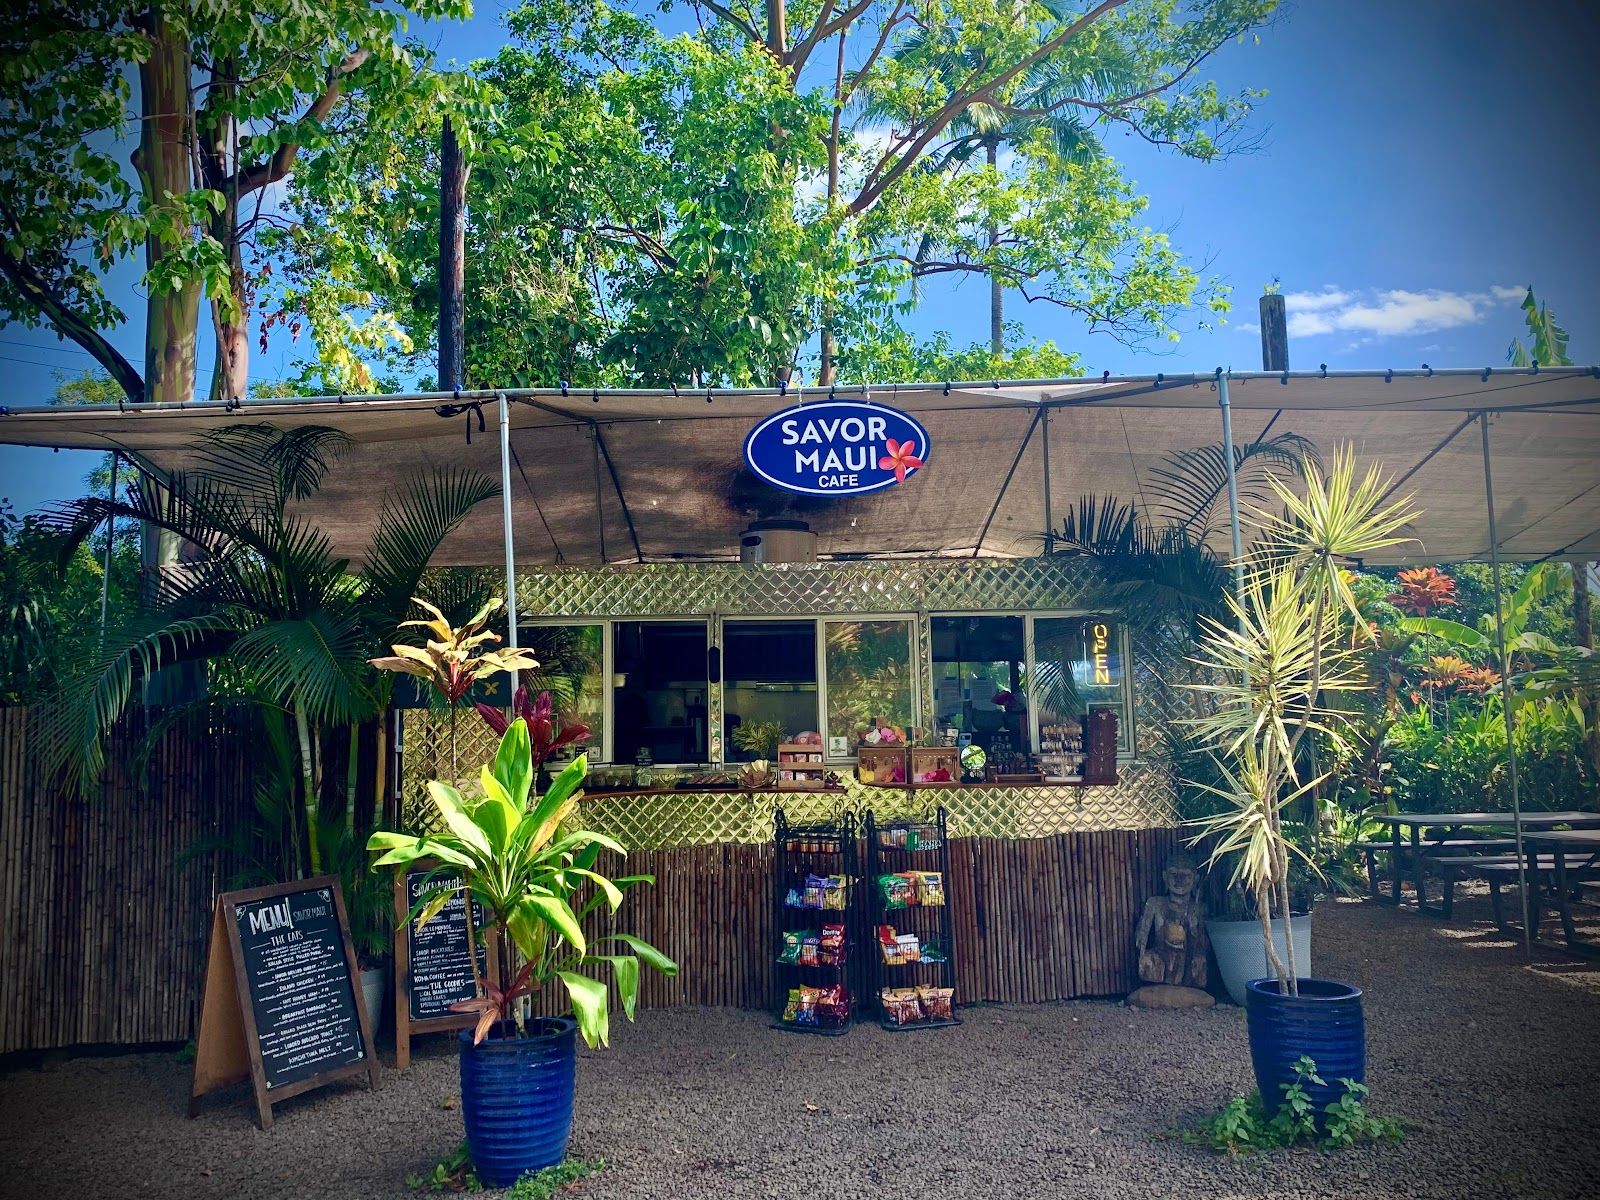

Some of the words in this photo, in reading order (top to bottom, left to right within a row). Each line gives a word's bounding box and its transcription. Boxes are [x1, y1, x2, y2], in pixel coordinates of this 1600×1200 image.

[781, 416, 887, 445] SAVOR
[795, 446, 877, 473] MAUI
[818, 474, 859, 488] CAFE
[1094, 624, 1110, 684] OPEN
[248, 901, 292, 935] MENU
[270, 934, 286, 946] THE
[287, 931, 304, 942] EATS
